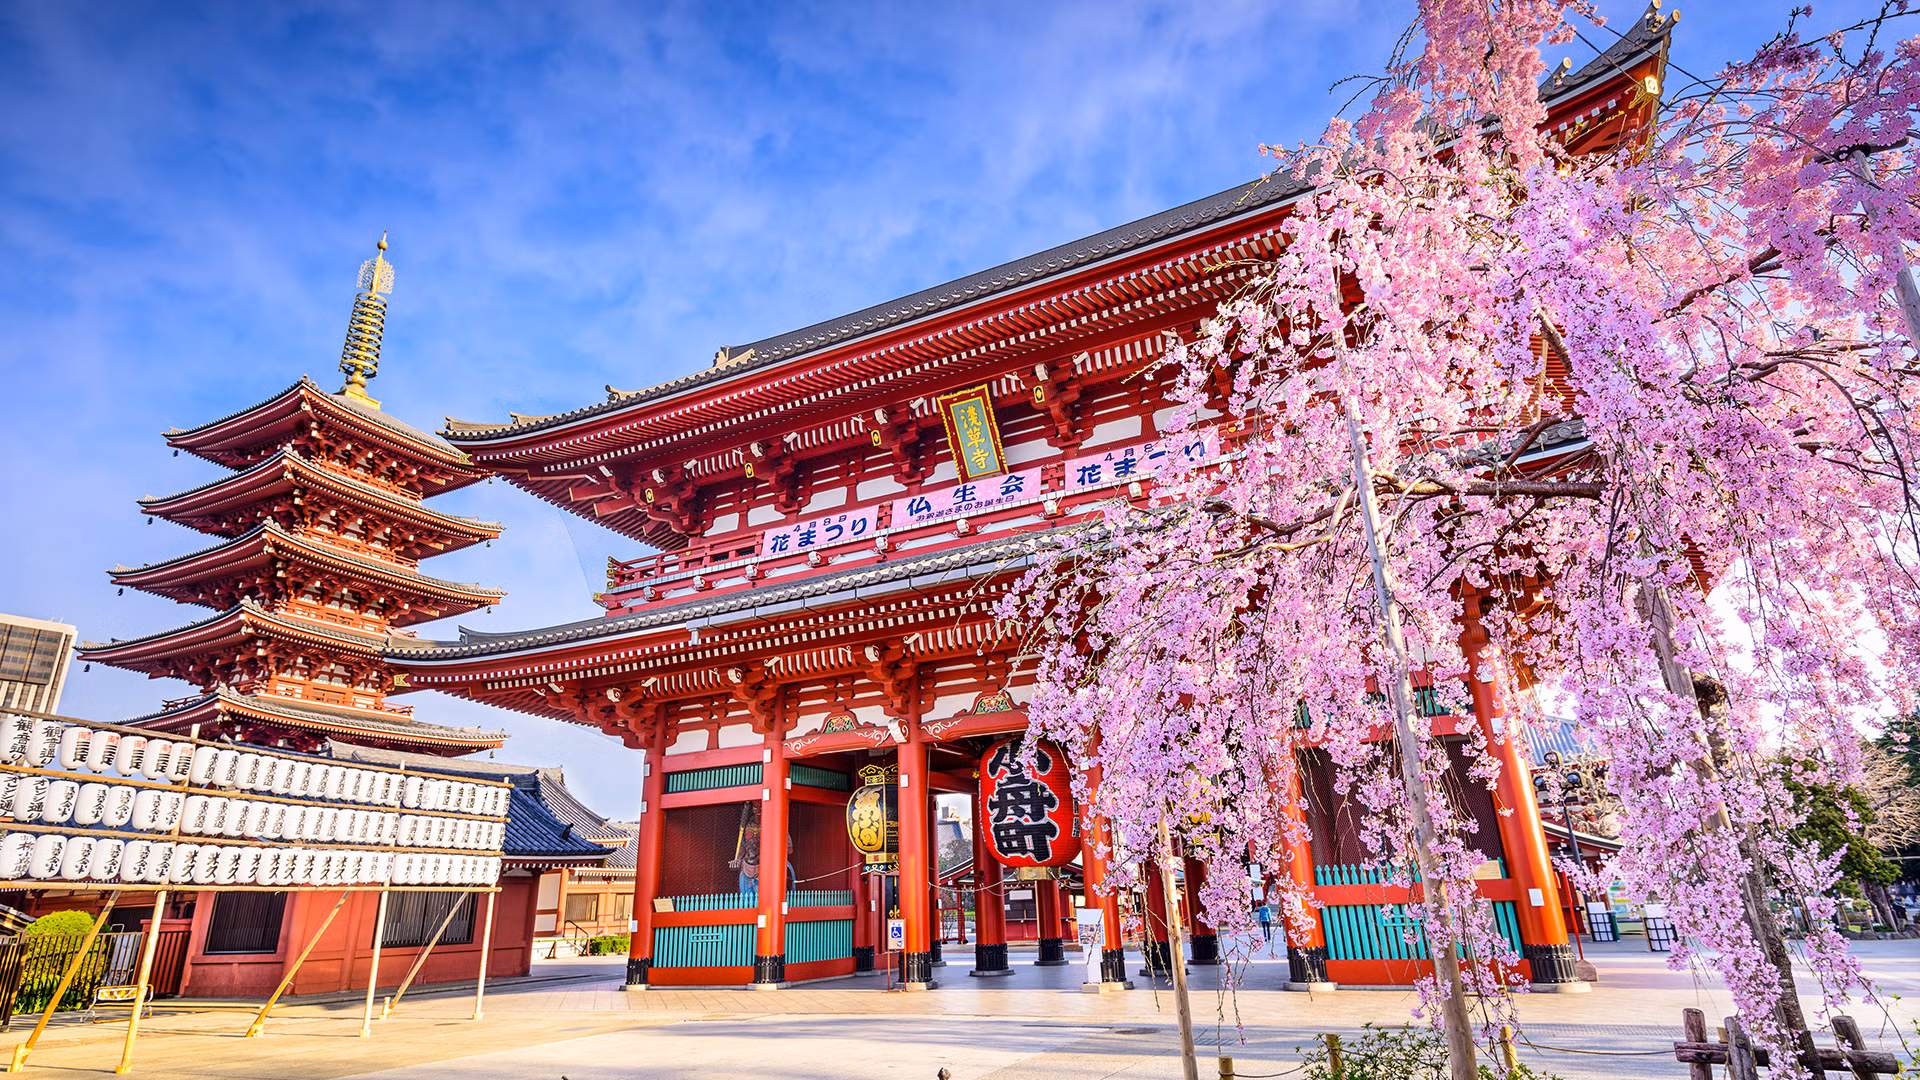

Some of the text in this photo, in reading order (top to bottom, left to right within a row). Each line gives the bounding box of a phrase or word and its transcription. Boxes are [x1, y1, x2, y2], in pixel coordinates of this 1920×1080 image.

[906, 475, 1026, 517] 仏生会
[770, 517, 868, 554] 花まつり
[793, 514, 847, 532] 4月8日
[9, 718, 33, 762] 観音通り
[39, 725, 62, 765] 観音通り
